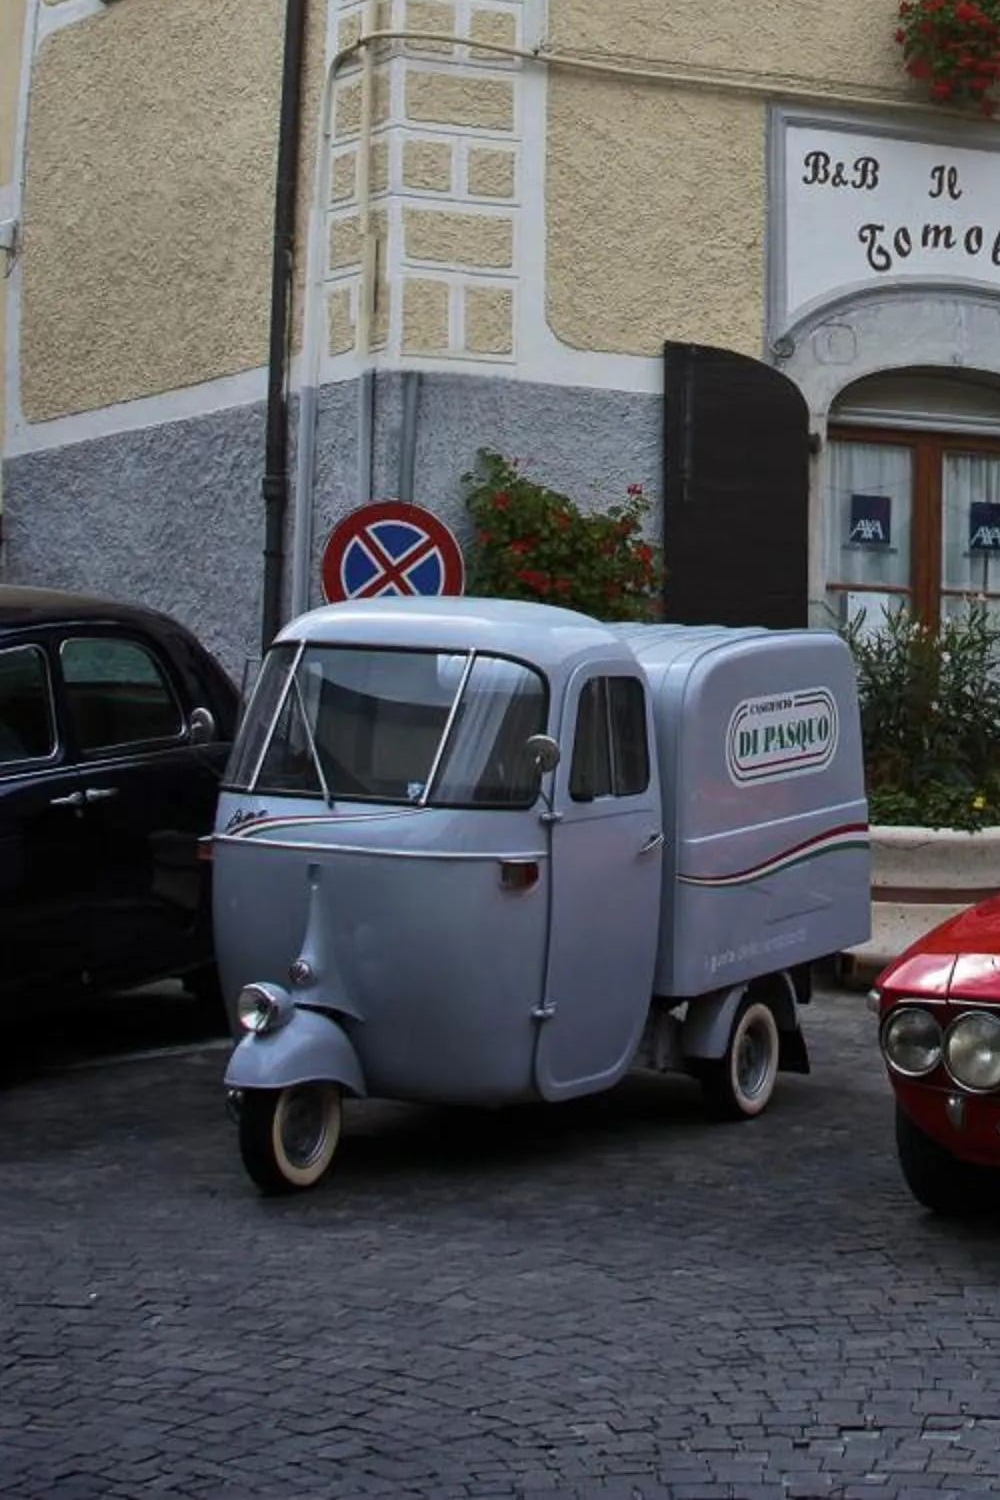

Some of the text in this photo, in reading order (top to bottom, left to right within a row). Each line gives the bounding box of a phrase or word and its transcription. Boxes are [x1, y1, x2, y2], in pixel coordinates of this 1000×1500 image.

[802, 150, 962, 199] B&B Il
[850, 518, 885, 541] AXA
[738, 715, 829, 758] DI PASQUO
